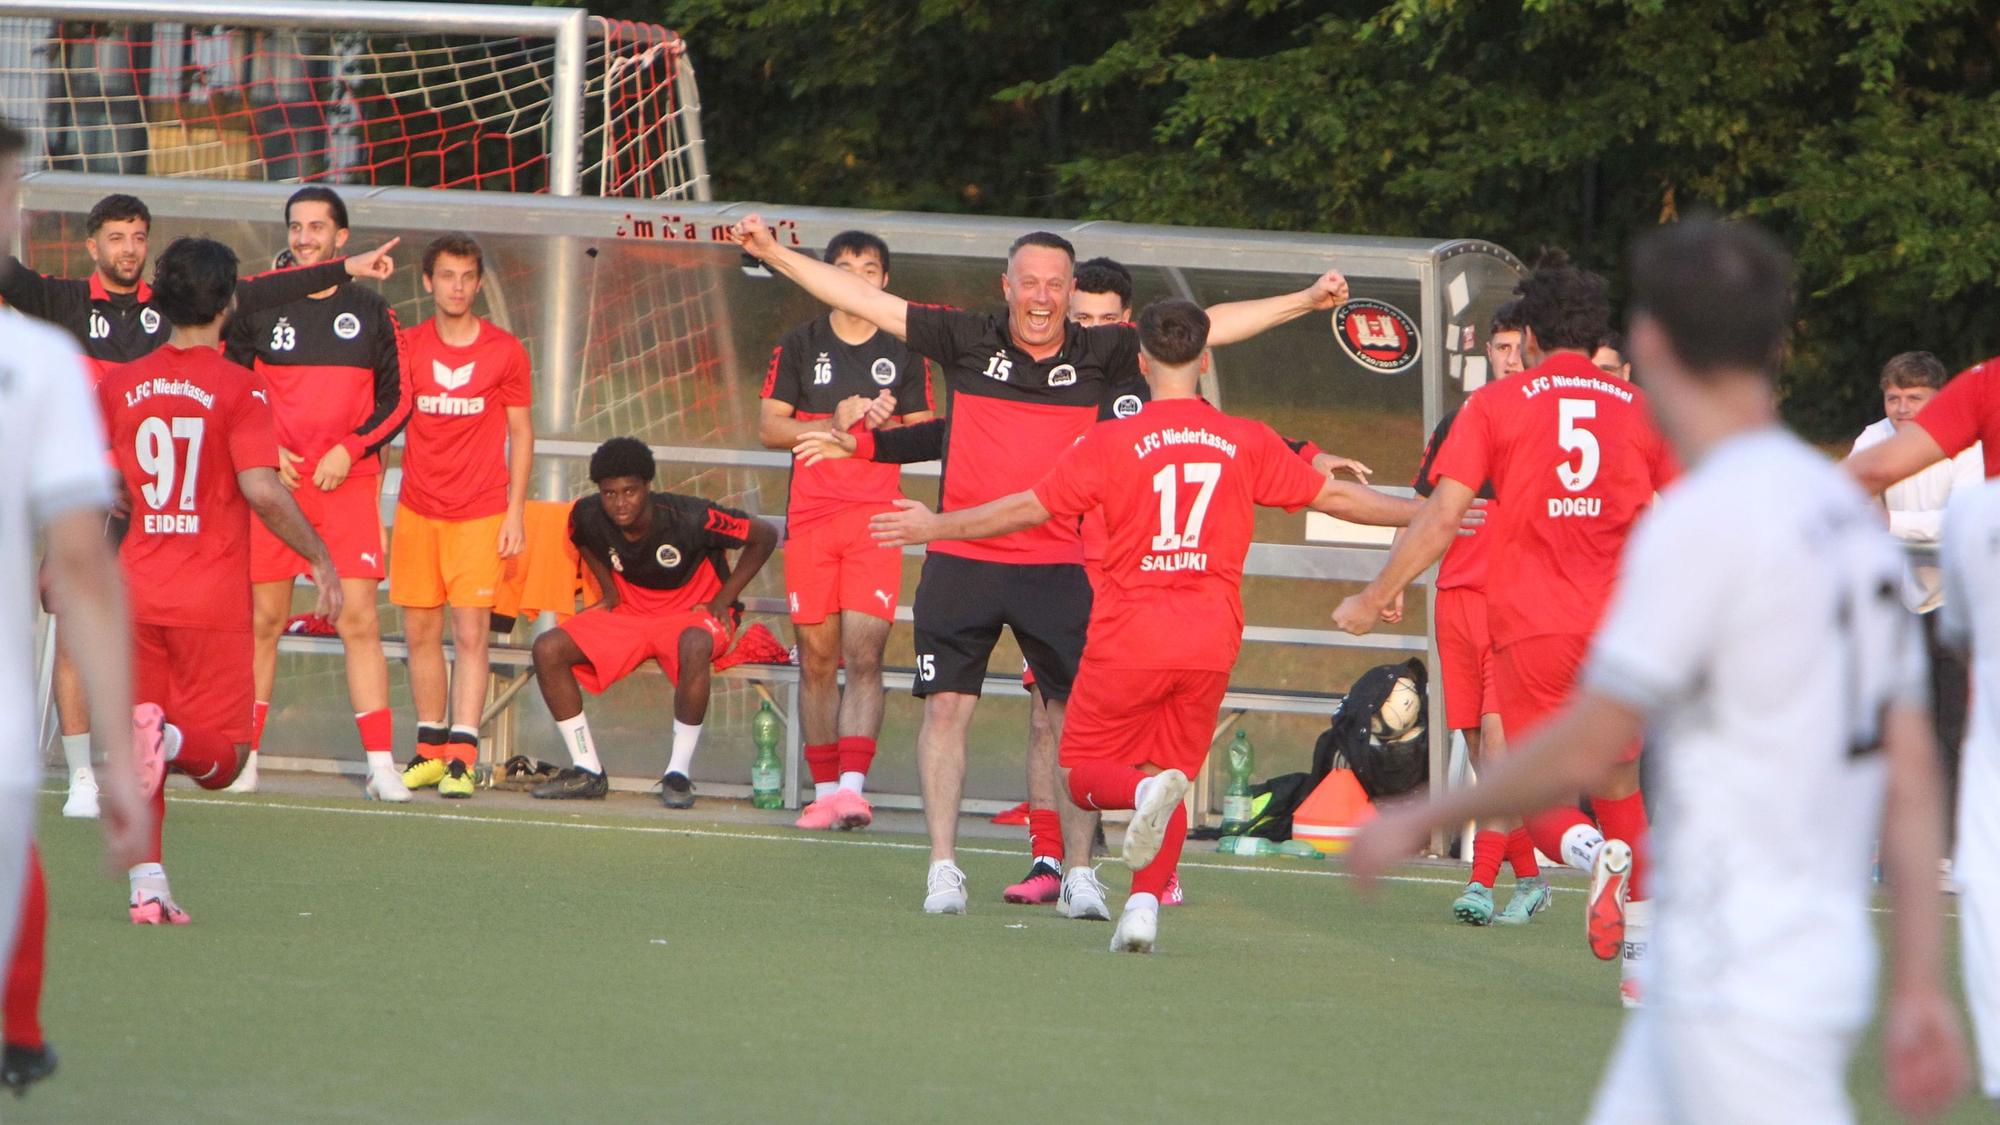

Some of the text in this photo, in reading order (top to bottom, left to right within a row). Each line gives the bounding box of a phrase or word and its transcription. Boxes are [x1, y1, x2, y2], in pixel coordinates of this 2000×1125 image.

[89, 313, 111, 338] 10
[270, 326, 296, 351] 33
[813, 362, 832, 385] 16
[983, 356, 1013, 382] 15
[125, 378, 215, 410] 1.FC Niederkassel
[1521, 375, 1633, 403] 1.FC Niederkassel
[417, 391, 485, 416] erima
[1134, 427, 1237, 459] 1.FC Niederkassel
[1555, 397, 1600, 492] 5
[135, 416, 204, 511] 97
[1151, 462, 1222, 551] 17
[1547, 497, 1601, 518] DOGU
